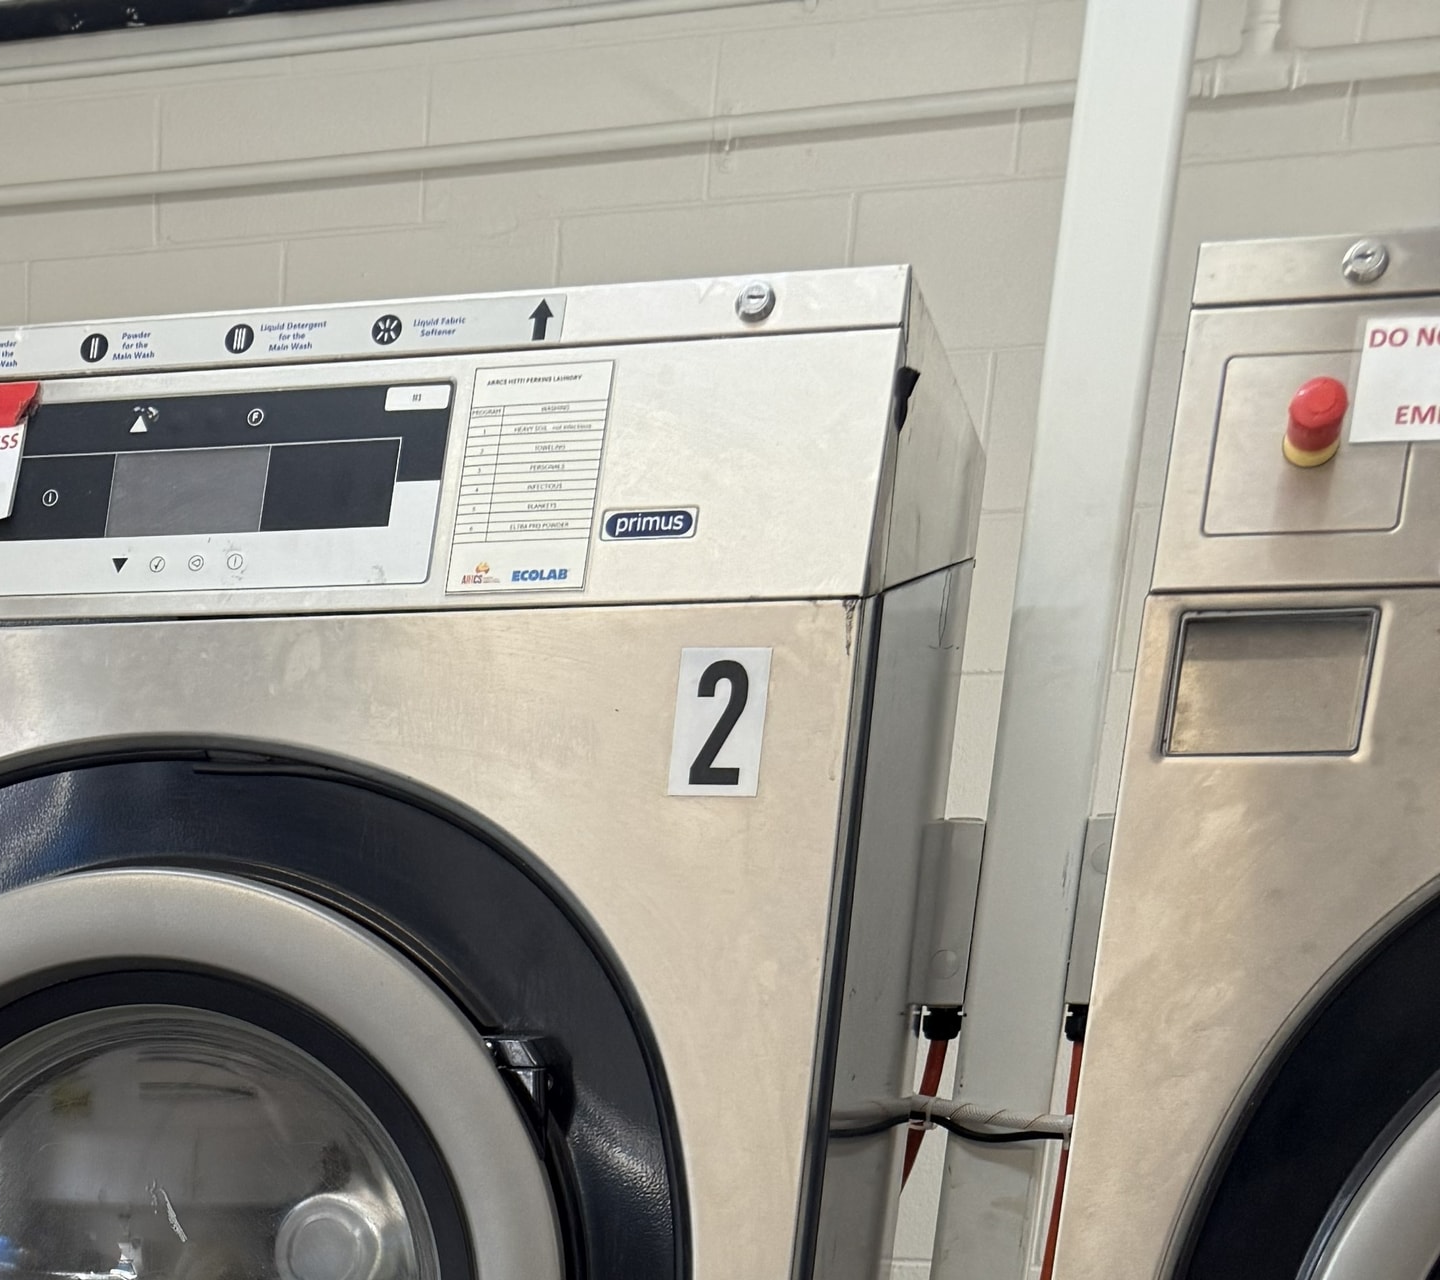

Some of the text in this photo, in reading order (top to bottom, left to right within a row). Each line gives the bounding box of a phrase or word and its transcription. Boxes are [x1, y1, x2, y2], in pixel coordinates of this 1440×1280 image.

[260, 320, 327, 332] Liquid Detergent
[413, 317, 466, 328] Liquid Fabric
[122, 331, 151, 340] Powder
[279, 332, 305, 341] for the
[420, 328, 456, 337] Softener
[1368, 328, 1409, 348] DO
[269, 341, 312, 351] Main Wash
[112, 350, 155, 360] Main Wash
[614, 513, 684, 537] primus
[511, 568, 569, 582] ECOLAB
[688, 659, 749, 785] 2
